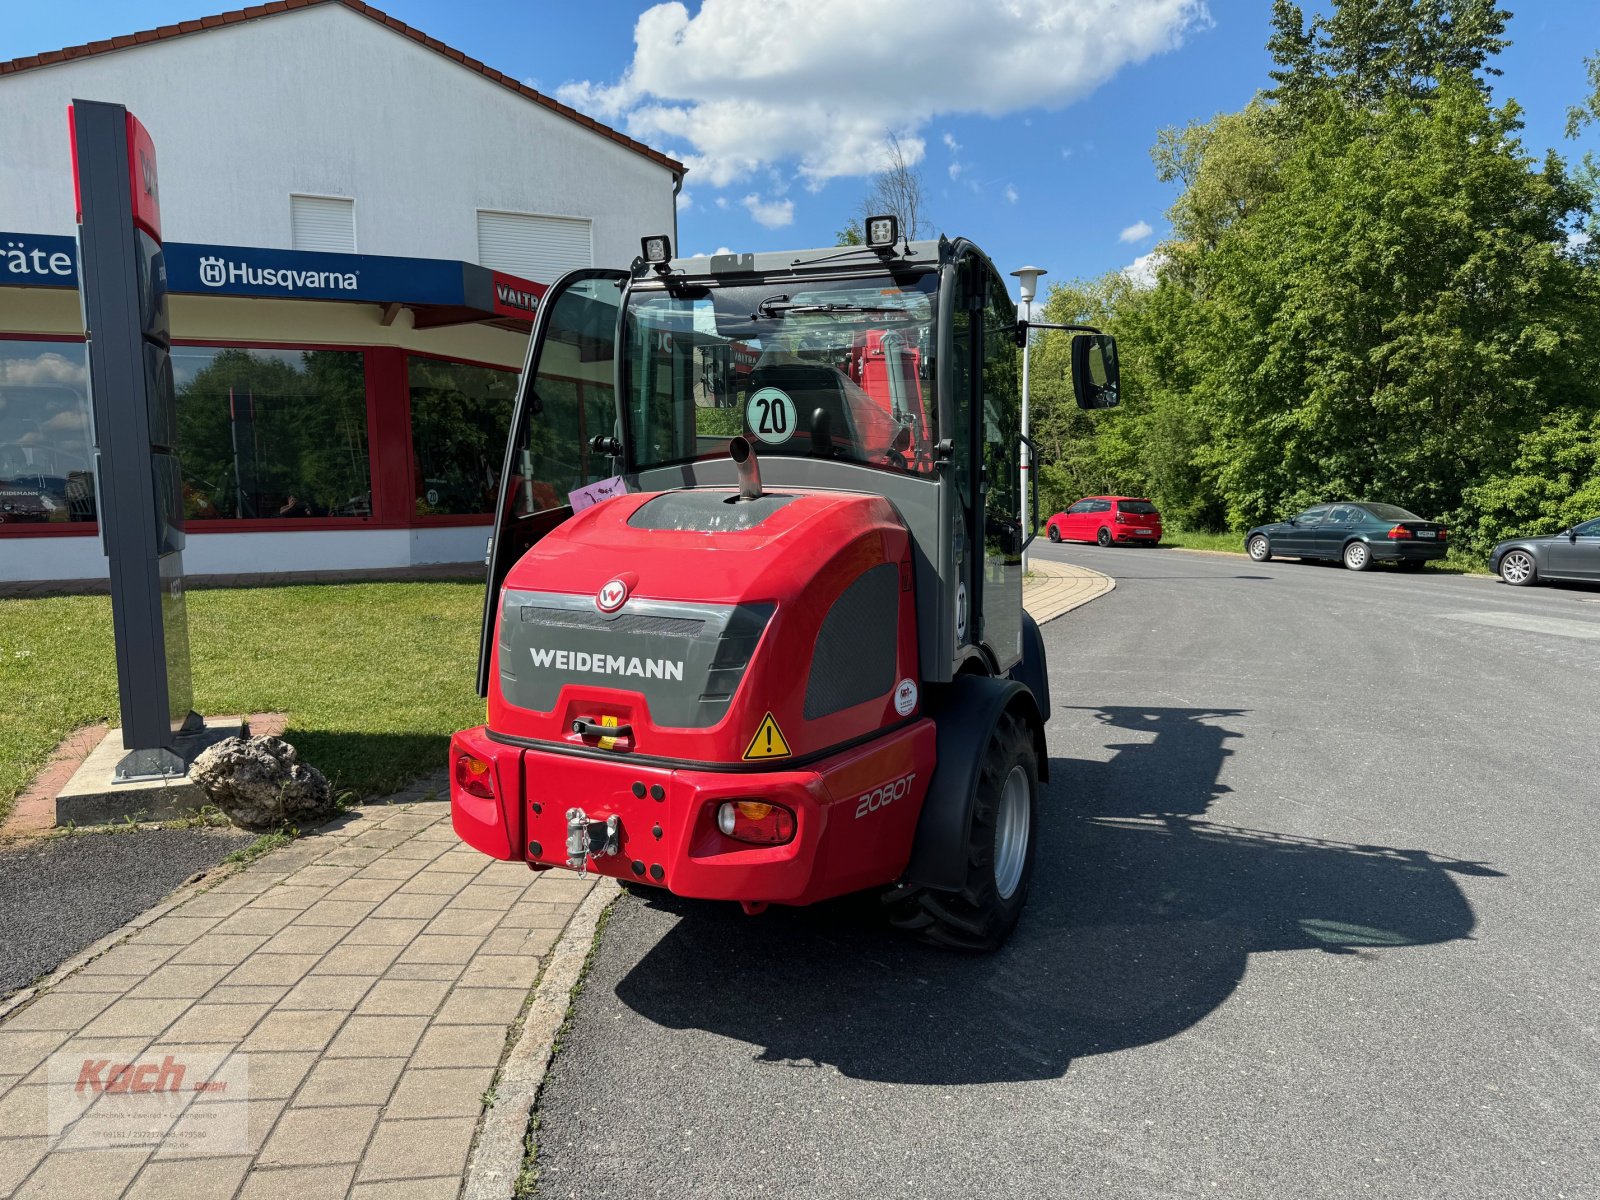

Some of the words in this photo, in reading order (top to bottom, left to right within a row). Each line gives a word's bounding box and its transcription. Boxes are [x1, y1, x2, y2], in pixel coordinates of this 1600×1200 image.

[228, 261, 358, 290] Husqvarna
[496, 282, 540, 312] VALTR
[756, 398, 787, 434] 20
[529, 647, 684, 681] WEIDEMANN
[855, 773, 916, 820] 2080T
